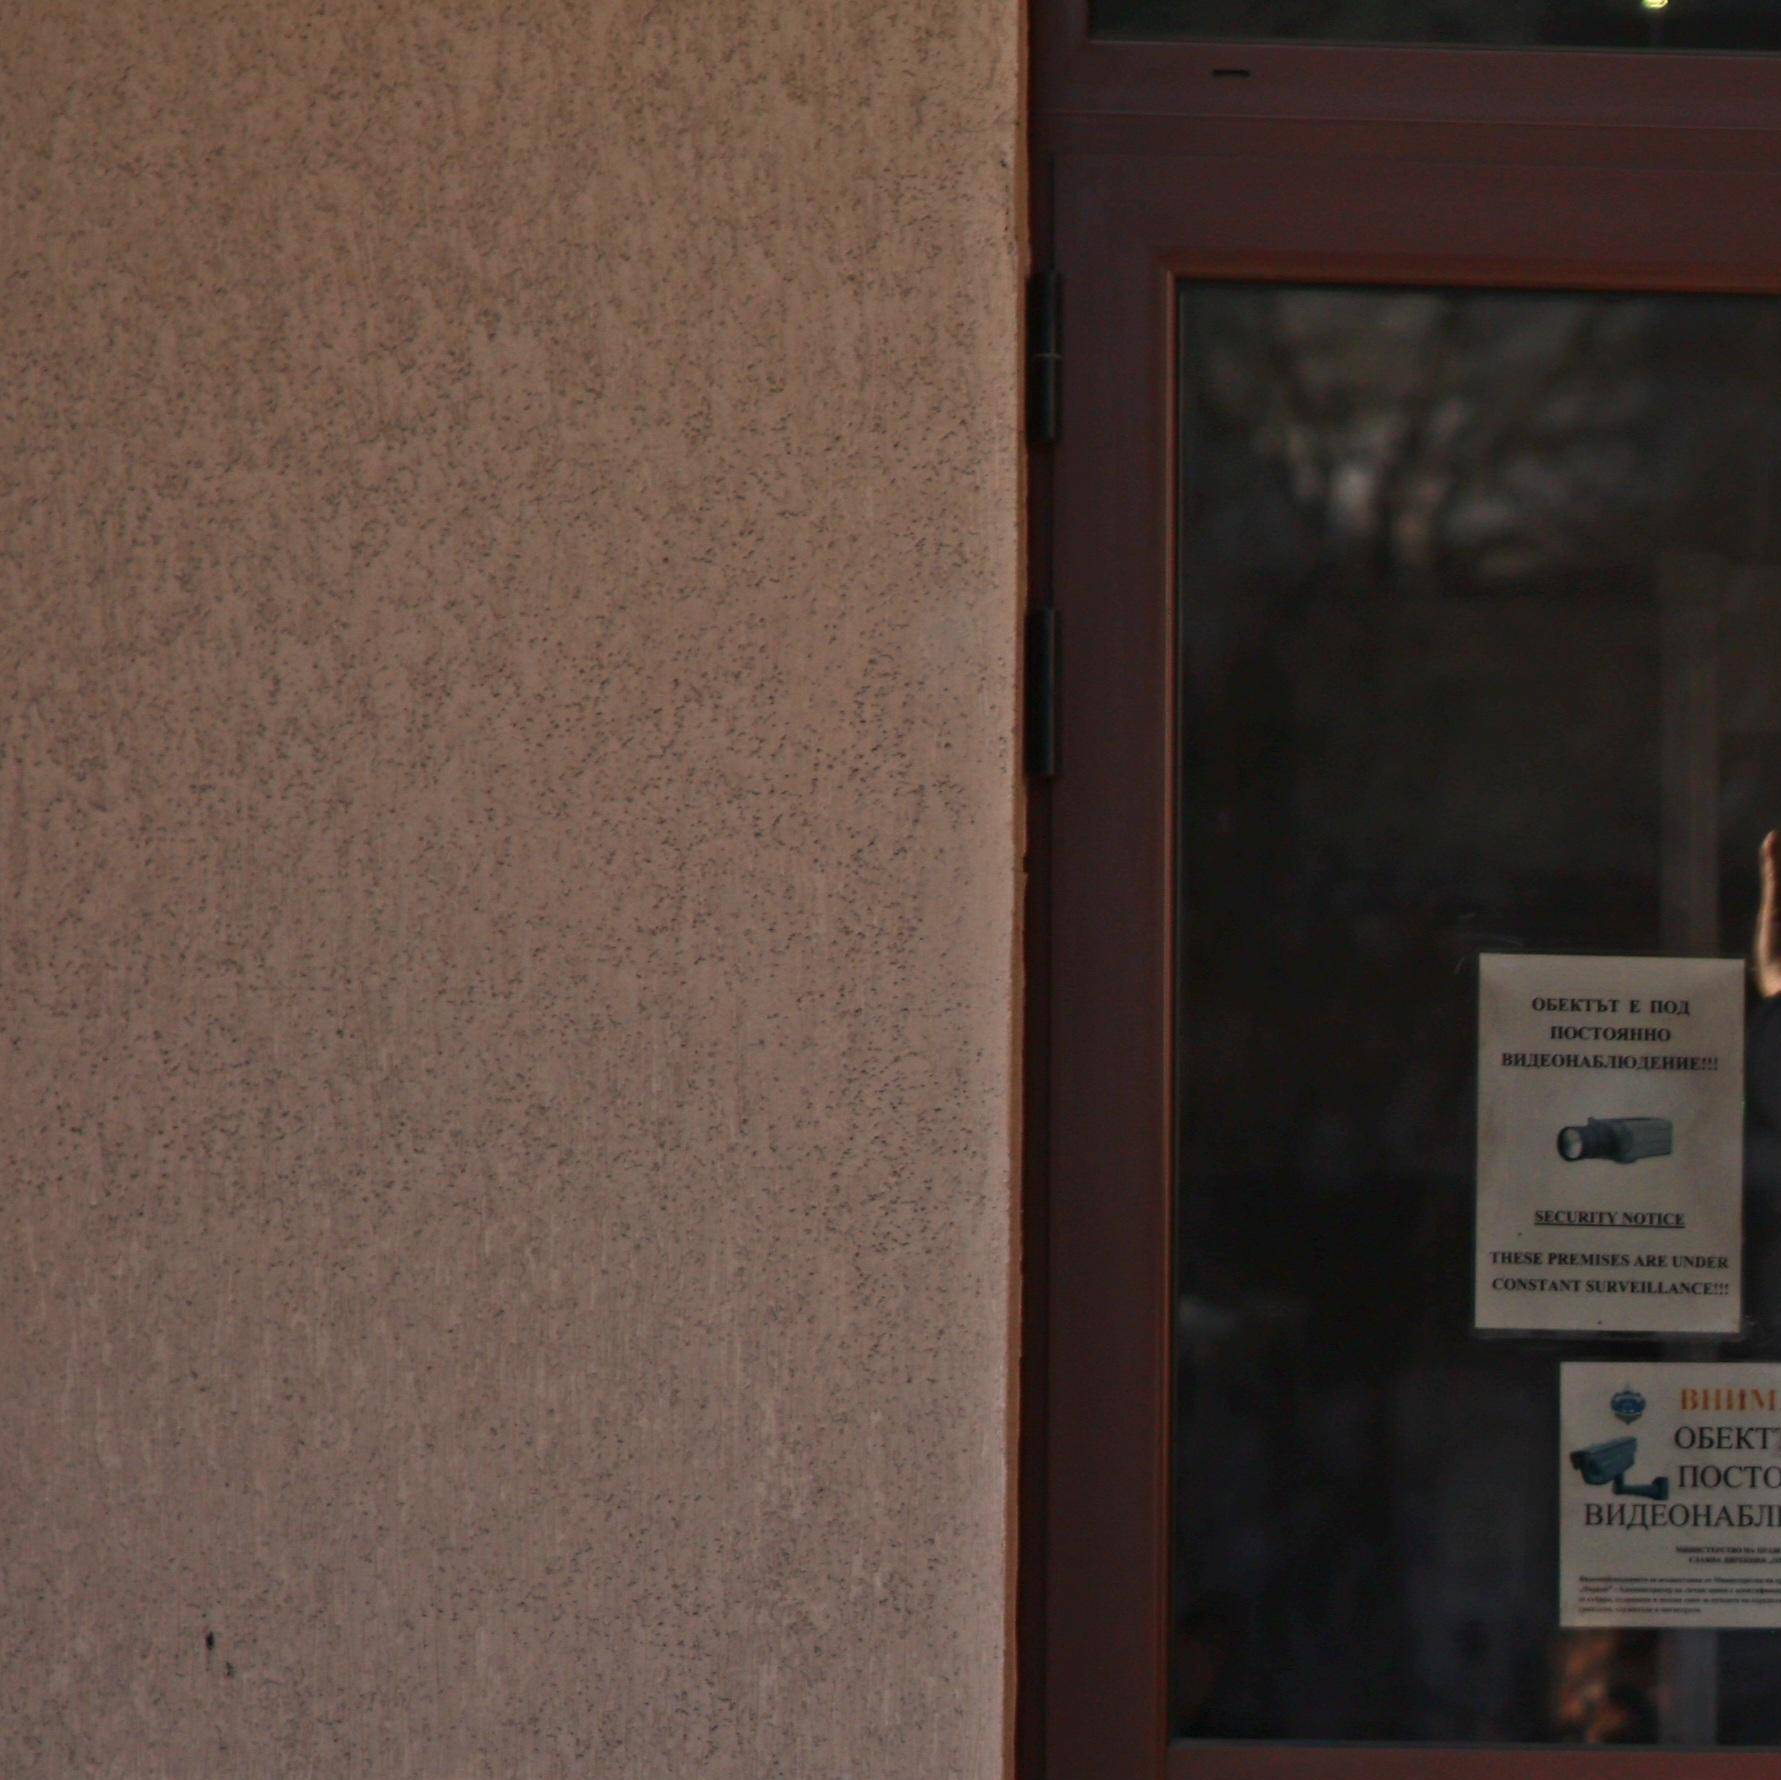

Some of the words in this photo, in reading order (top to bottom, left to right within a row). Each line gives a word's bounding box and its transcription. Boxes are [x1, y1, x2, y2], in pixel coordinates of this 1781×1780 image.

[1531, 997, 1617, 1013] ОБЕКТЪТ
[1629, 999, 1641, 1013] Е
[1650, 1000, 1690, 1016] ПОД
[1549, 1025, 1672, 1042] ПОСТОЯННО
[1501, 1052, 1719, 1072] ВИДЕОНАБЛЮДЕНИЕ!!!
[1534, 1210, 1618, 1226] SECURITY
[1622, 1212, 1686, 1228] NOTICE
[1489, 1251, 1543, 1266] THESE
[1548, 1252, 1630, 1268] PREMISES
[1633, 1254, 1668, 1268] ARE
[1672, 1255, 1729, 1270] UNDER
[1492, 1278, 1581, 1293] CONSTANT
[1585, 1280, 1729, 1296] SURVEILLANCE!!!
